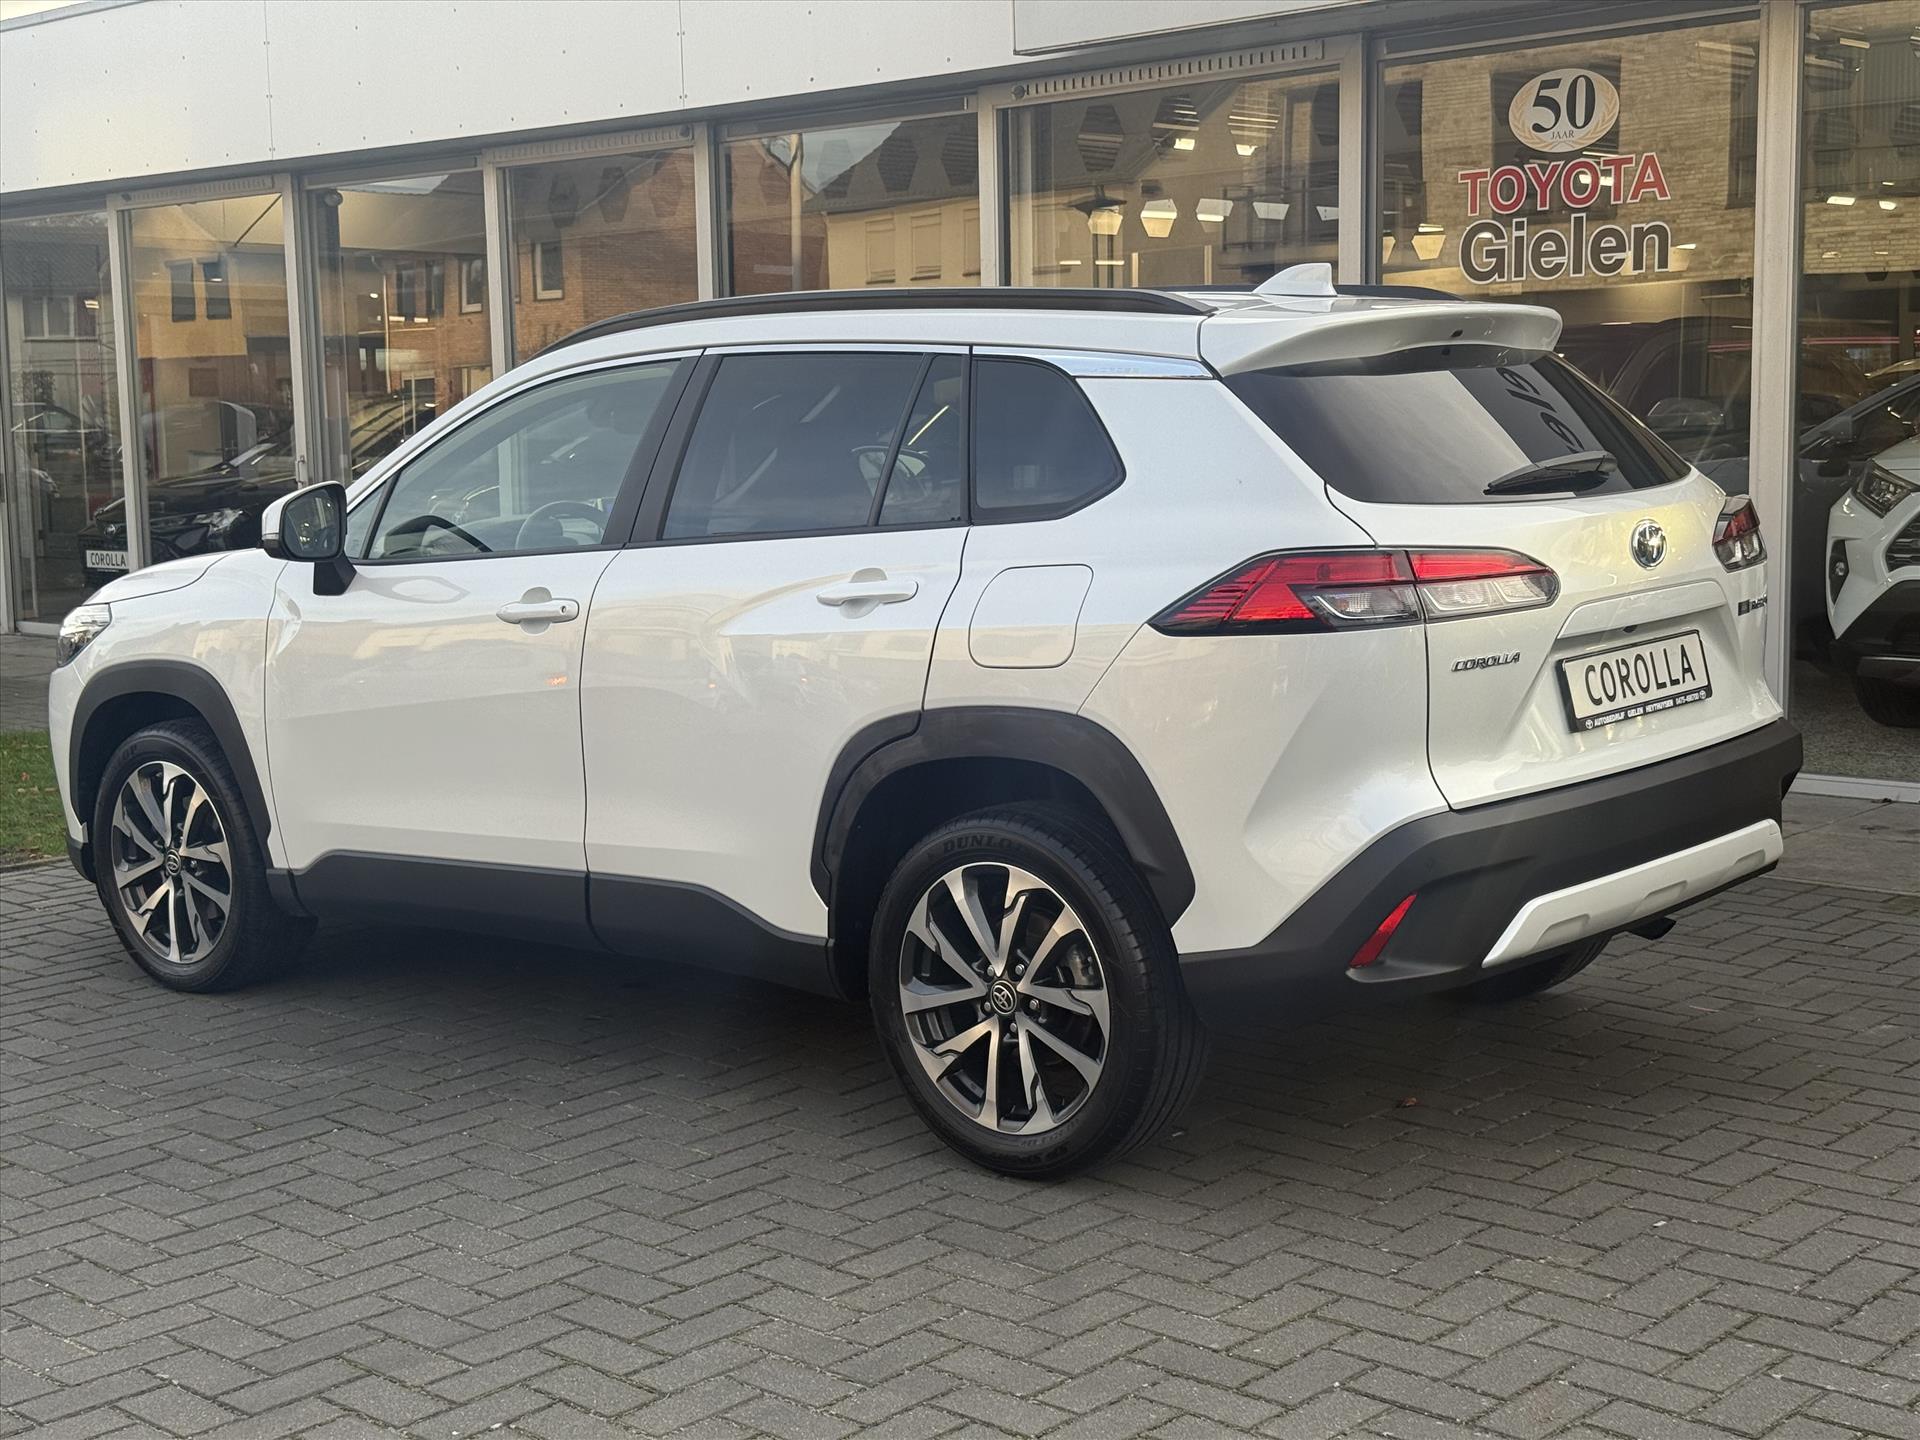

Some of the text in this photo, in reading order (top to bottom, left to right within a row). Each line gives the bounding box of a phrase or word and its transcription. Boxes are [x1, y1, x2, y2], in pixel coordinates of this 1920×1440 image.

[1531, 74, 1596, 133] 50
[1551, 130, 1575, 141] JAAR
[1458, 152, 1671, 216] TOYOTA
[1459, 213, 1671, 285] Gielen
[90, 552, 127, 567] COROLLA
[1451, 650, 1521, 672] COROLLA
[1584, 644, 1696, 706] COROLLA
